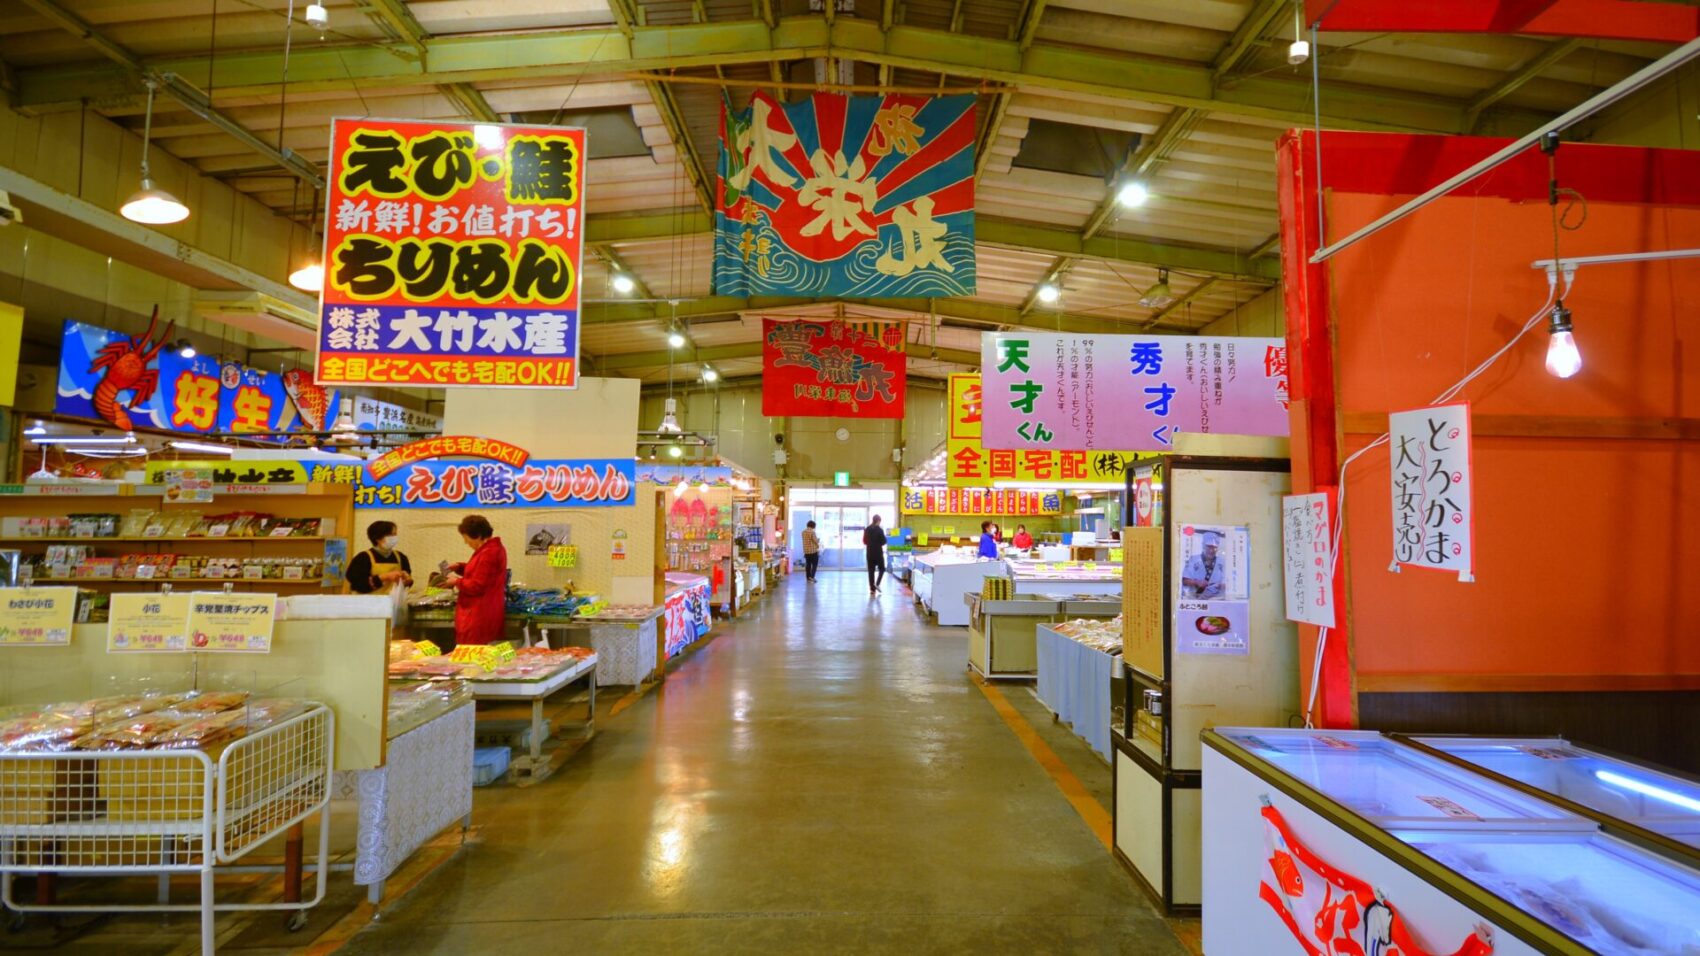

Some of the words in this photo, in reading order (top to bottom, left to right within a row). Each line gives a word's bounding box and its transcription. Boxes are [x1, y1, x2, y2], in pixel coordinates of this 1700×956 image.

[340, 129, 577, 205] えび・鮭
[335, 199, 577, 239] 新鮮!お値打ち!
[331, 234, 577, 303] ちりめん
[328, 307, 381, 330] 株式
[387, 308, 569, 354] 大竹水産
[327, 329, 380, 351] 会社
[322, 357, 571, 385] 全国どこへでも宅配OK!!
[996, 338, 1053, 443] 天才くん
[312, 464, 363, 484] 新鮮!
[370, 437, 522, 476] 全国どこでも宅配OK!!
[905, 491, 923, 510] 活
[1042, 493, 1061, 512] 魚
[1395, 435, 1422, 563] 大安売り
[1425, 418, 1462, 564] とろかま
